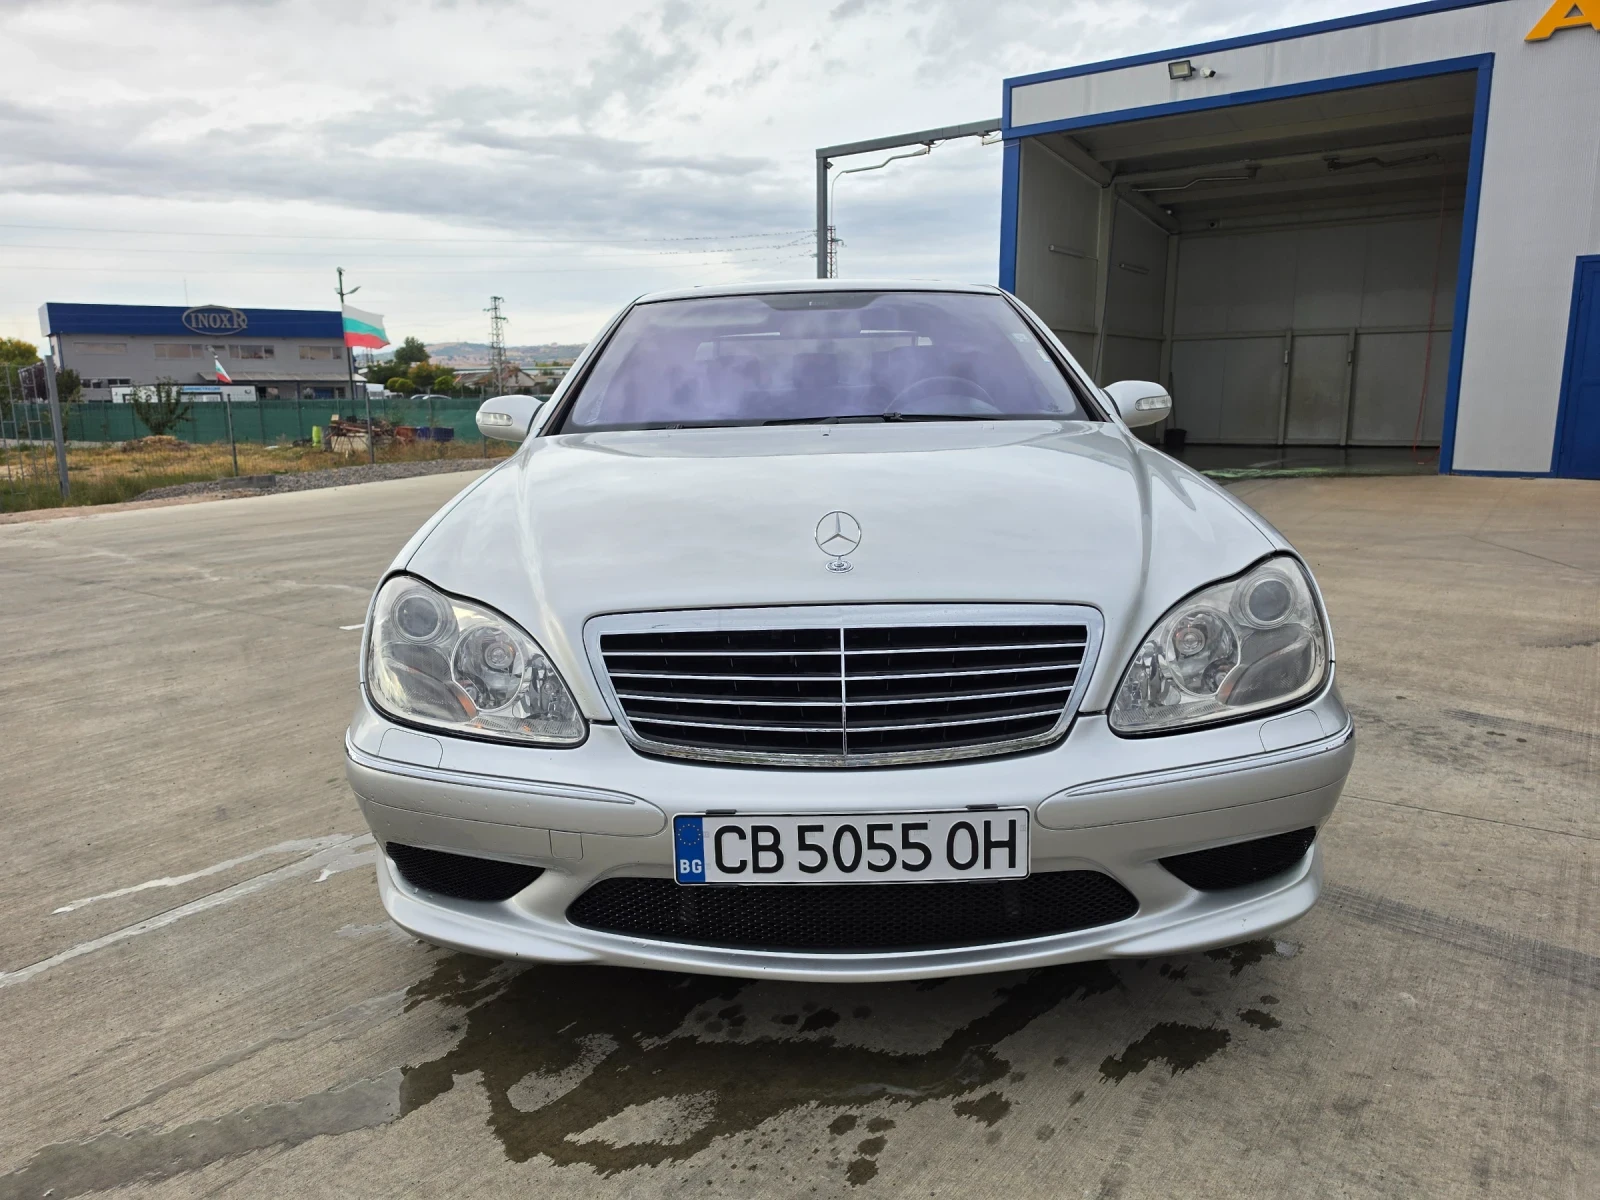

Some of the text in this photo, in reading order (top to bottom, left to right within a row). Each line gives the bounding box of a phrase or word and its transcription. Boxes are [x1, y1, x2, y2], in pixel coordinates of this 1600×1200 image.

[714, 825, 784, 874] CB
[797, 822, 932, 873] 5055
[680, 859, 702, 874] BG
